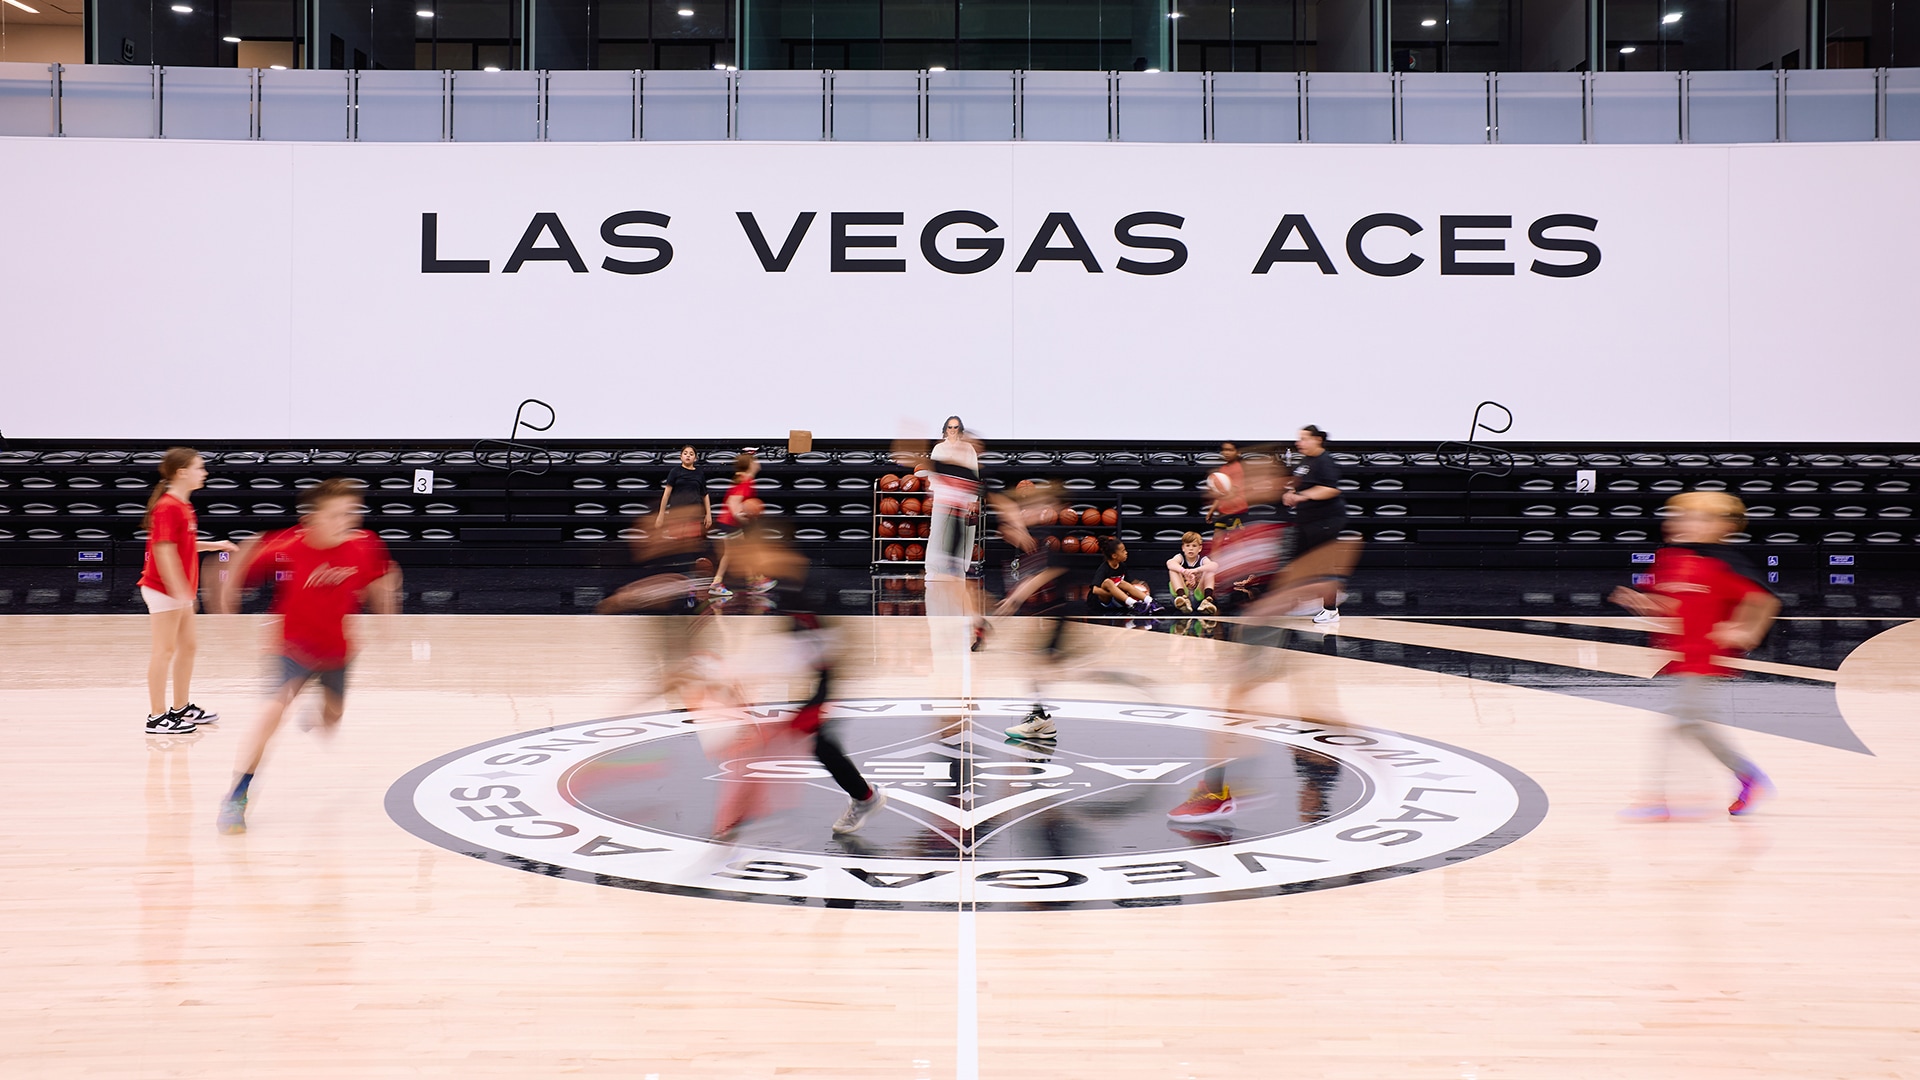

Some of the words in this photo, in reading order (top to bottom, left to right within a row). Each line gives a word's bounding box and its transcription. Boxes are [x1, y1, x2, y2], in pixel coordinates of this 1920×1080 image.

[421, 211, 674, 275] LAS
[736, 210, 1188, 276] VEGAS
[1252, 212, 1602, 278] ACES
[417, 477, 427, 492] 3
[1579, 478, 1590, 492] 2
[1118, 708, 1440, 768] WORLD
[742, 760, 1191, 780] ACES
[449, 784, 673, 857] ACES
[1335, 786, 1477, 847] LAS
[711, 850, 1332, 890] VEGAS
